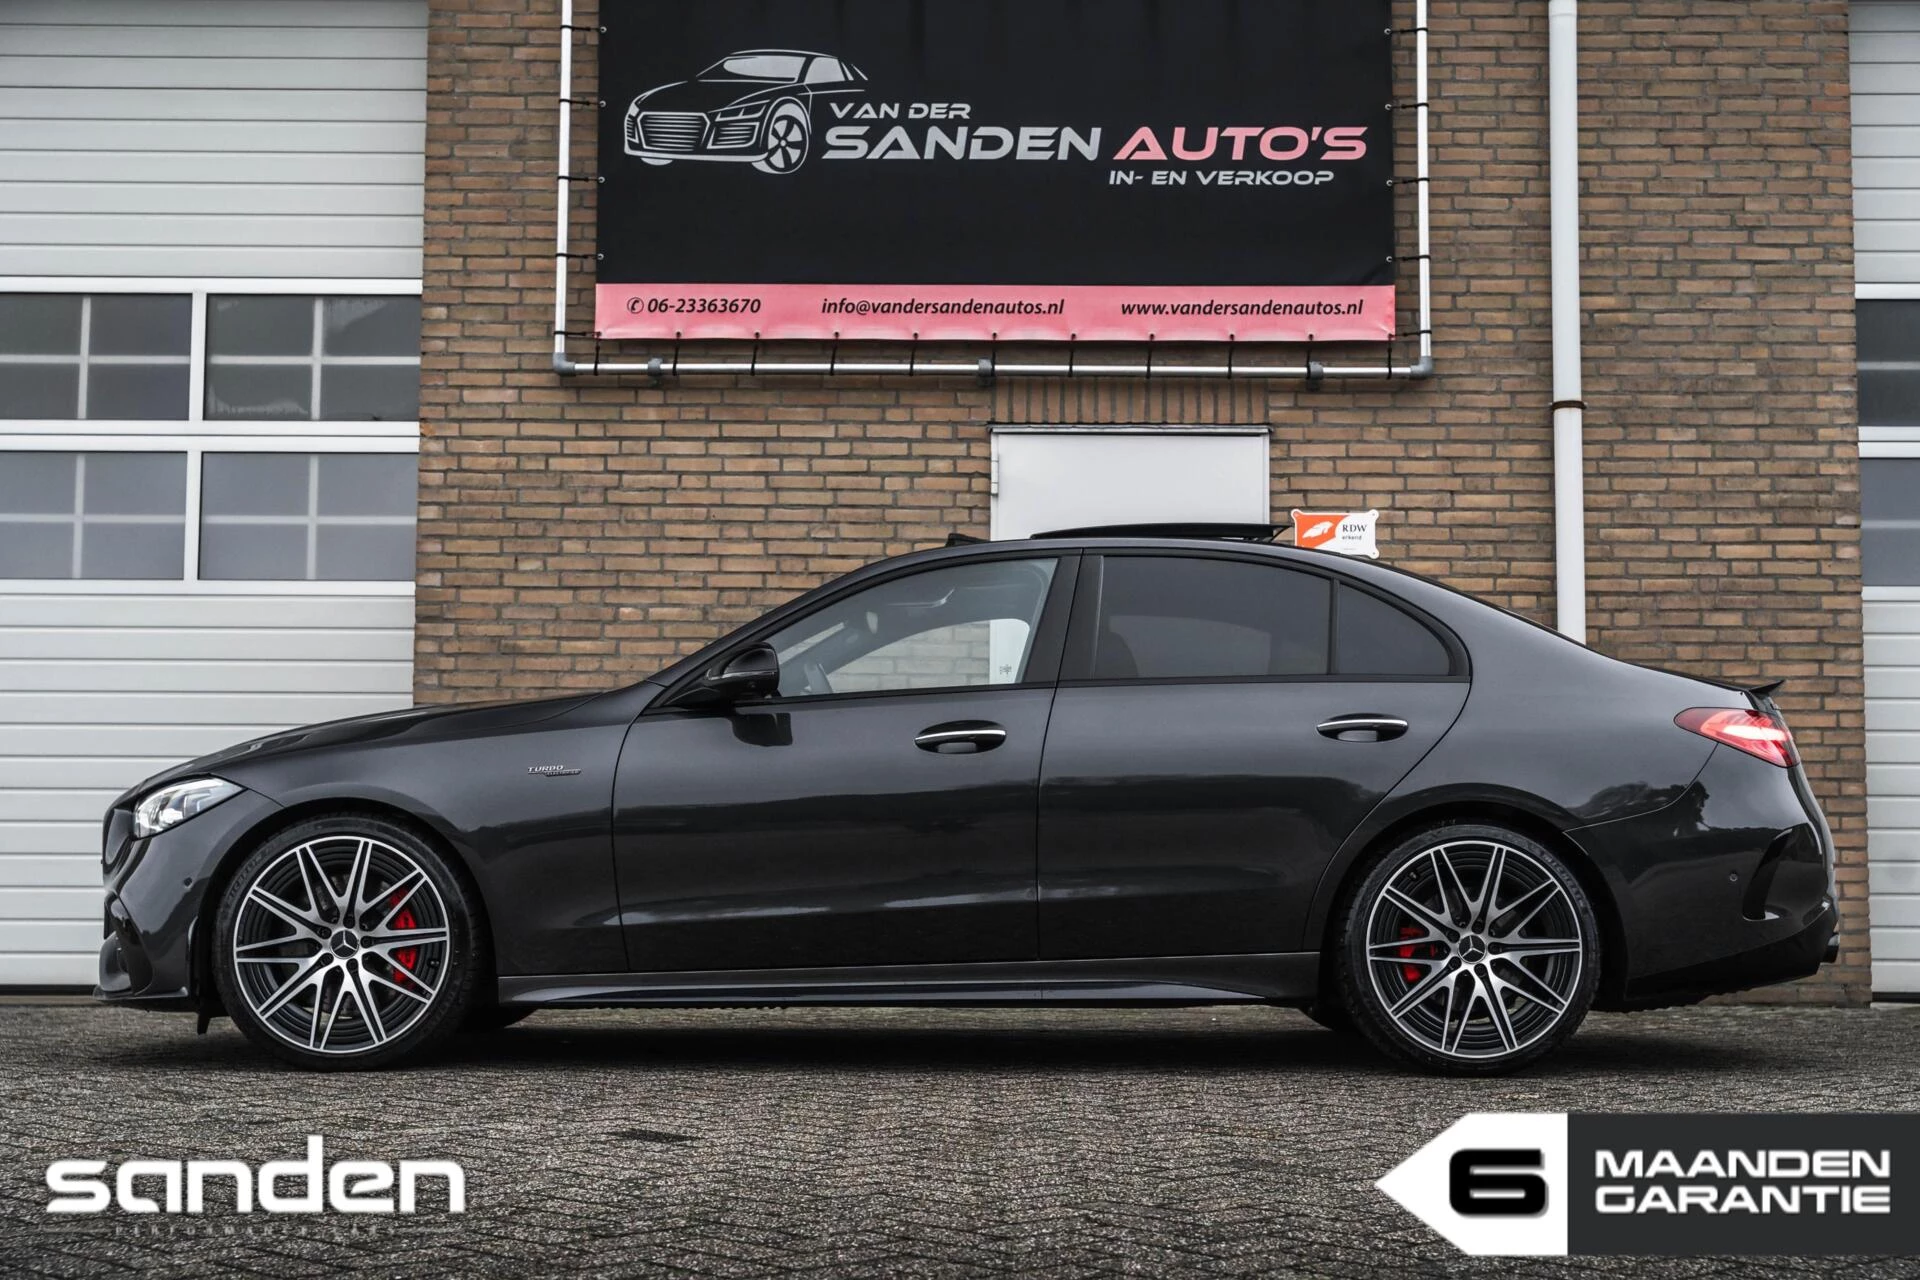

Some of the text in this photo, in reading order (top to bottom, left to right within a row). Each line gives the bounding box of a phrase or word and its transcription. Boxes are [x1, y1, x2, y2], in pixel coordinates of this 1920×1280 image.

[829, 102, 972, 119] VAN DER
[821, 125, 1368, 161] SANDEN AUTO'S
[1108, 169, 1335, 186] IN- EN VERKOOP
[647, 297, 1364, 316] 06-23363670 info@vandersandenautos.nl www.vandersandenautos.nl
[1342, 523, 1367, 532] RDW
